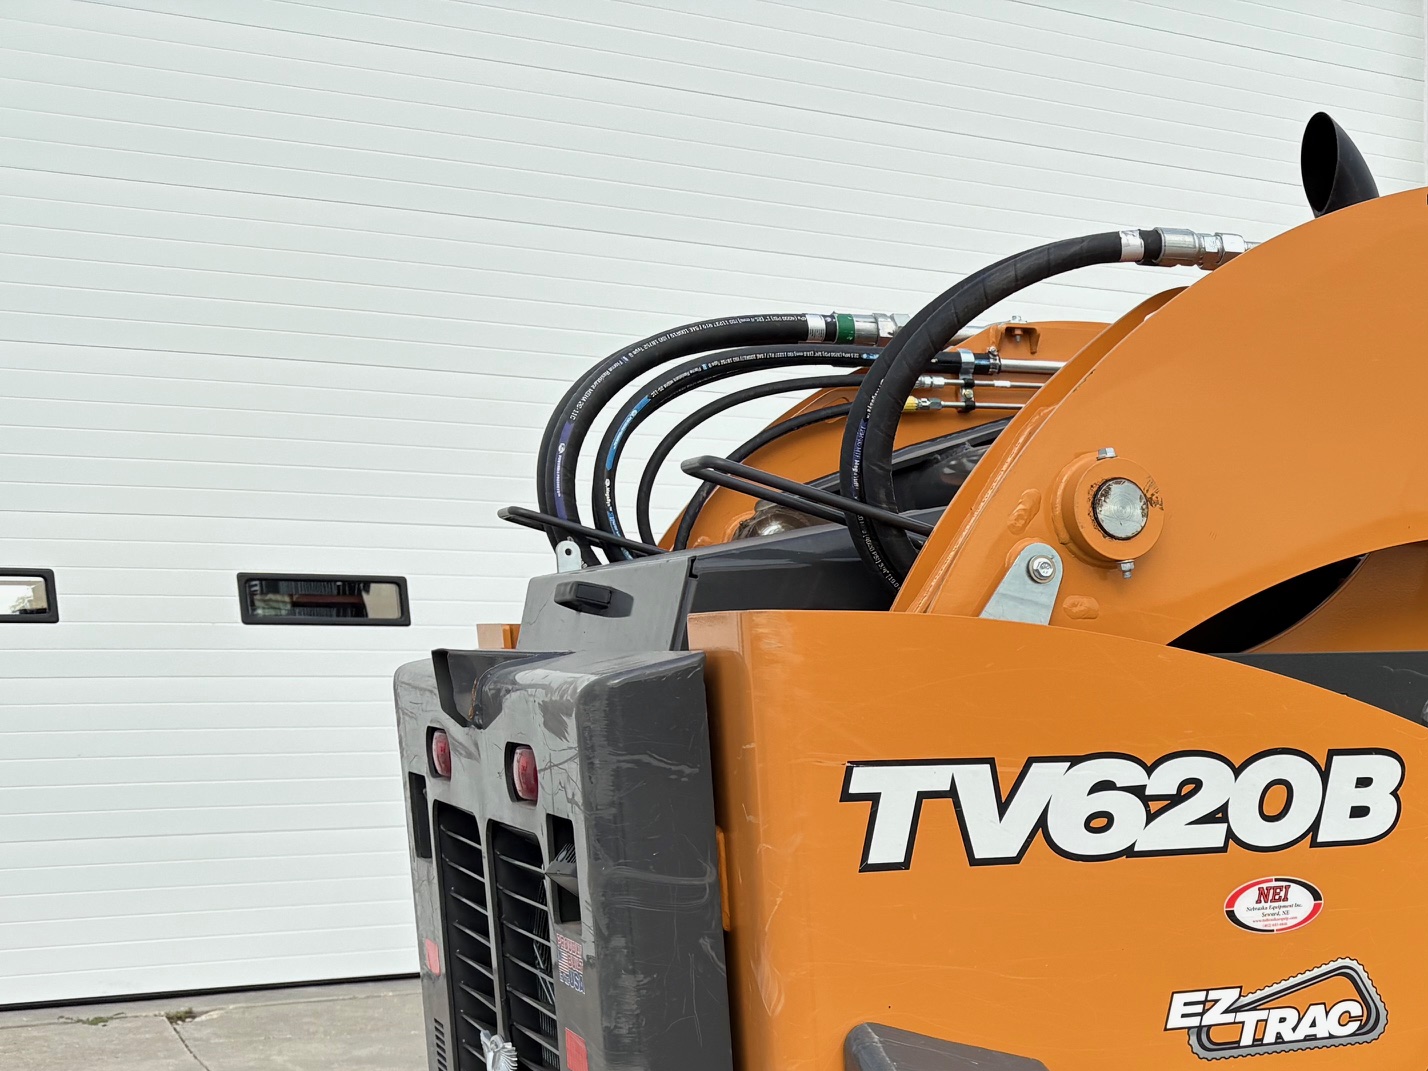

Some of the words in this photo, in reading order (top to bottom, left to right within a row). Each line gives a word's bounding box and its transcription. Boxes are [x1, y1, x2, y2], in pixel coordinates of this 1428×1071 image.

[840, 747, 1406, 873] TV620B
[1256, 884, 1291, 904] NEI
[1268, 903, 1294, 911] Equipment
[1163, 986, 1243, 1031] EZ
[1234, 999, 1364, 1047] TRAC
